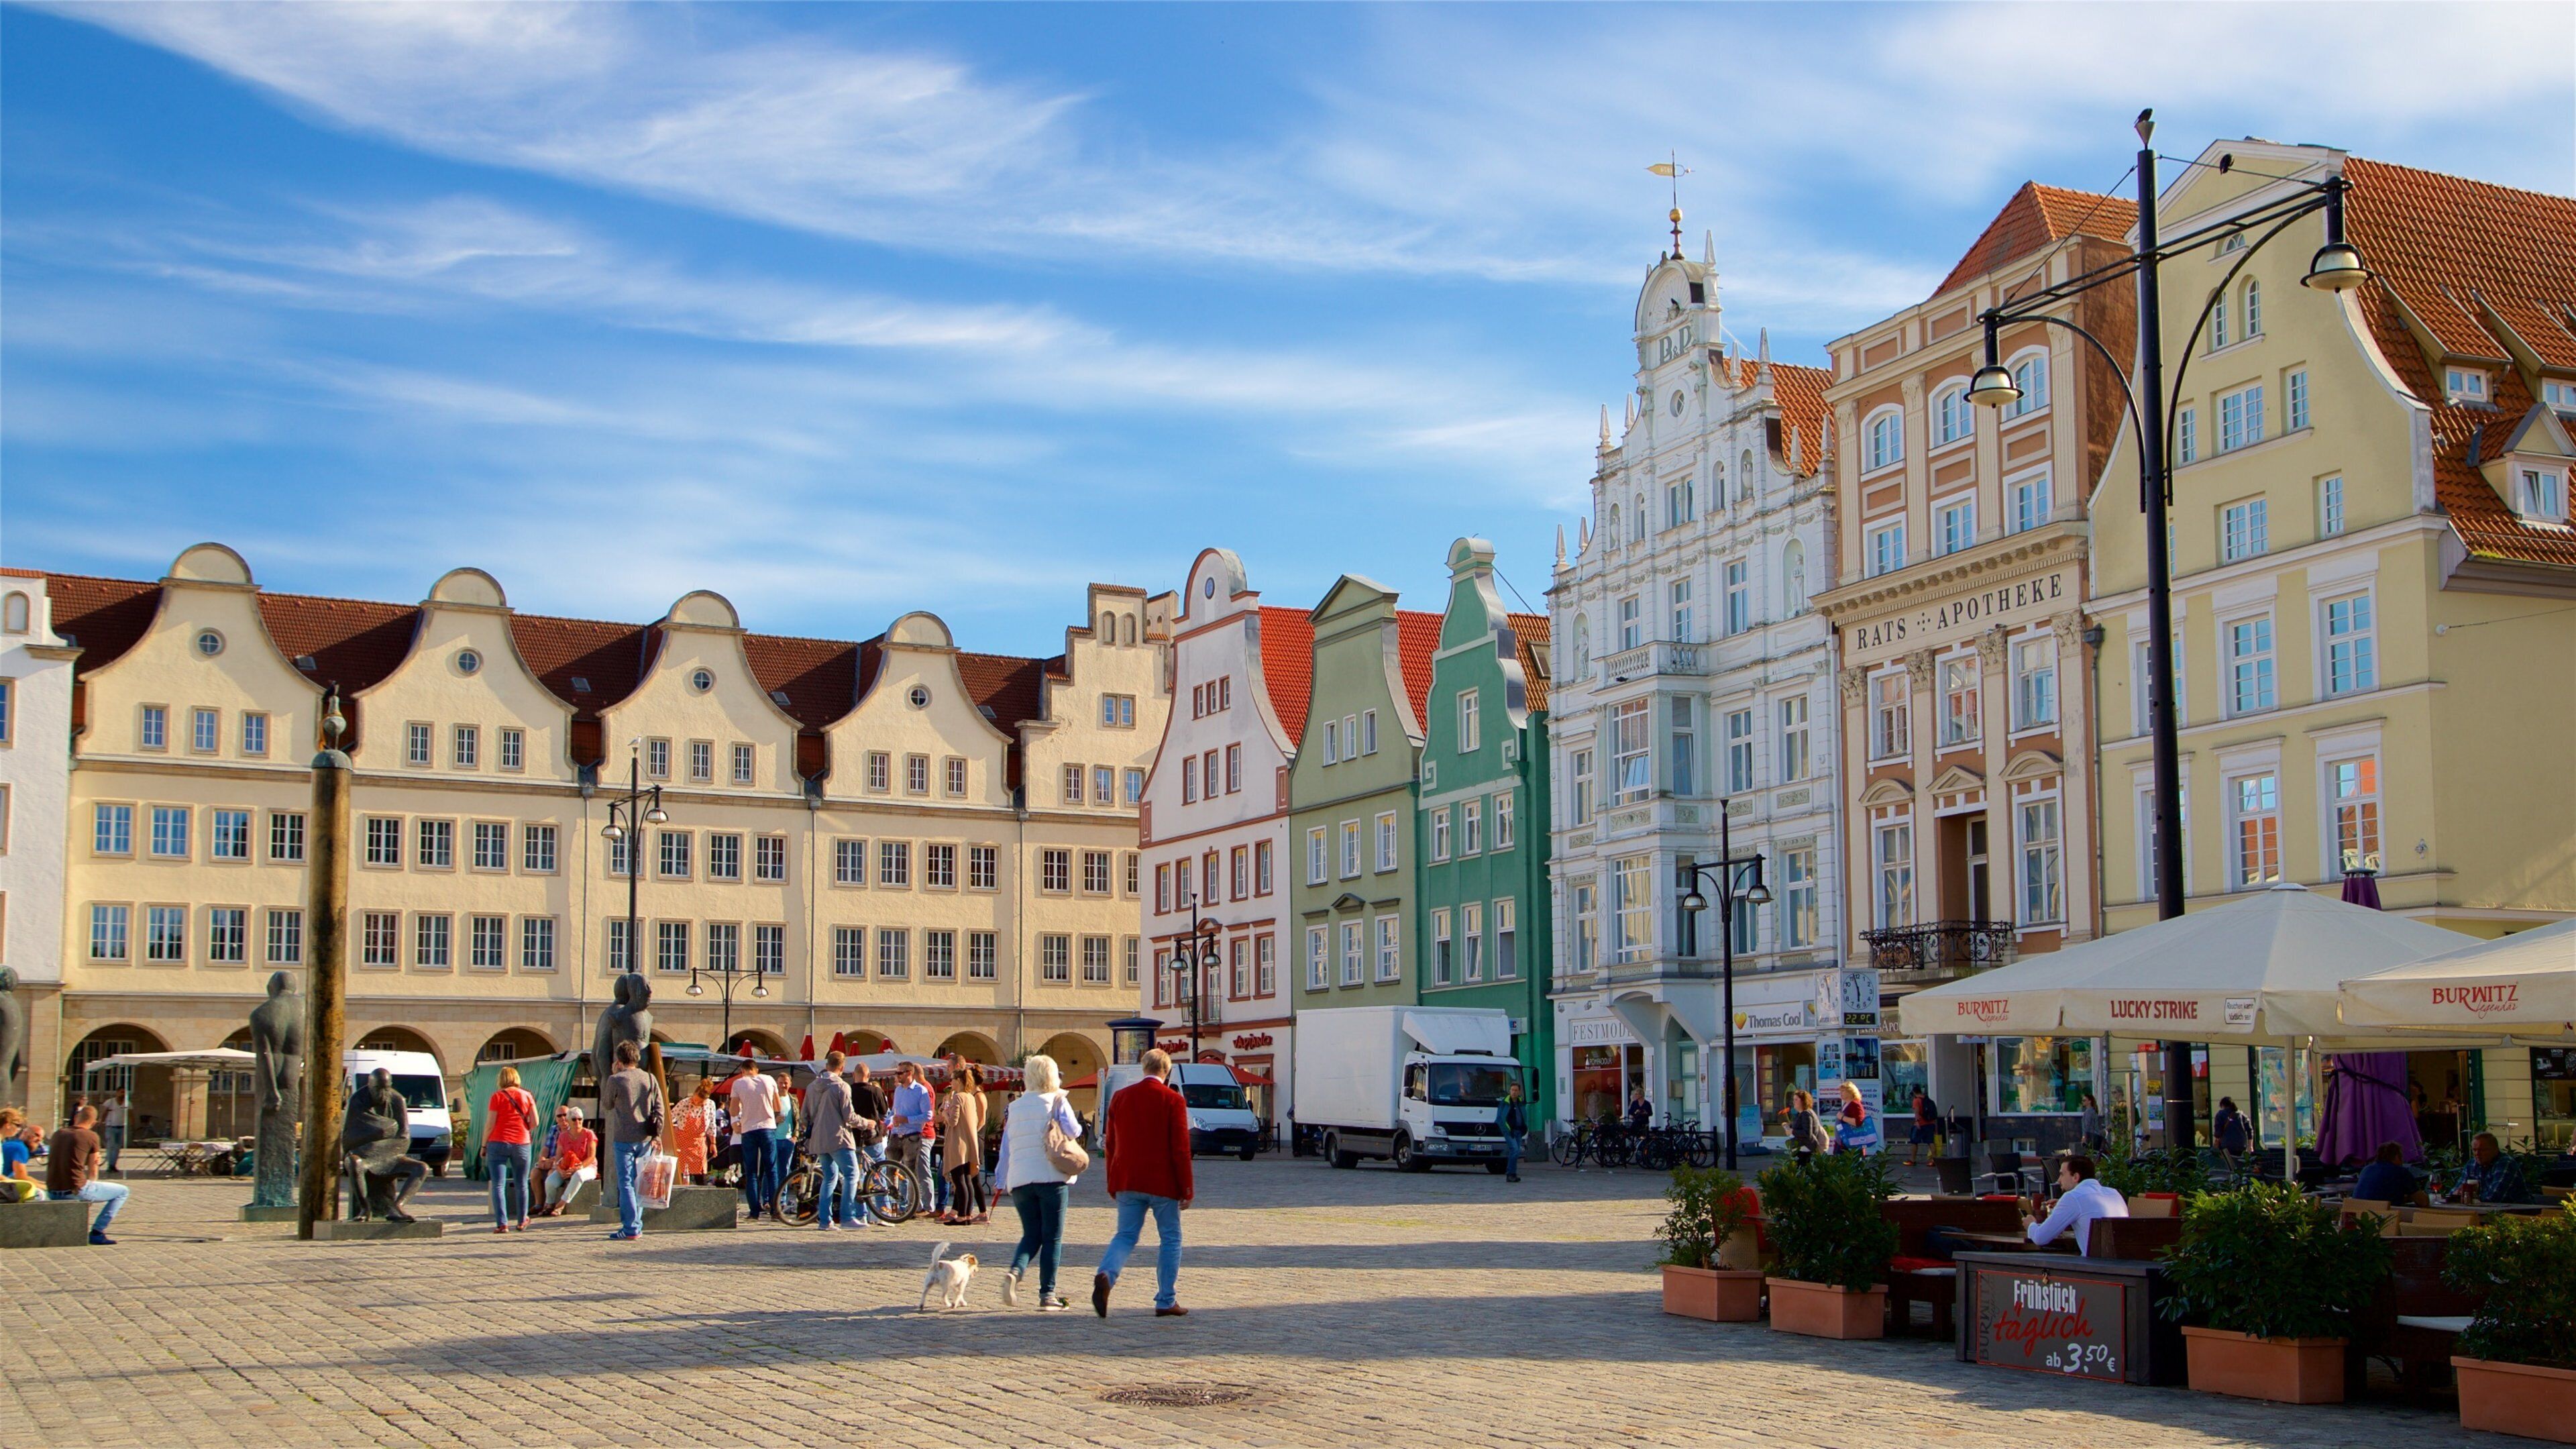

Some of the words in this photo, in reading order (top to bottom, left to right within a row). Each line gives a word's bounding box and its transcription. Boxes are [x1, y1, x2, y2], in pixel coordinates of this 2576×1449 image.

[1857, 618, 1907, 649] RATS
[1937, 574, 2062, 629] APOTHEKE
[2432, 985, 2518, 1012] BURWITZ
[1845, 1014, 1857, 1024] 22
[1957, 1000, 2009, 1021] BURWITZ
[2110, 1000, 2152, 1018] LUCKY
[2153, 1000, 2198, 1019] STRIKE
[1748, 1014, 1782, 1028] Thomas
[2014, 1279, 2076, 1313] Frühstück
[1993, 1297, 2093, 1358] täglich
[2046, 1352, 2061, 1368] ab
